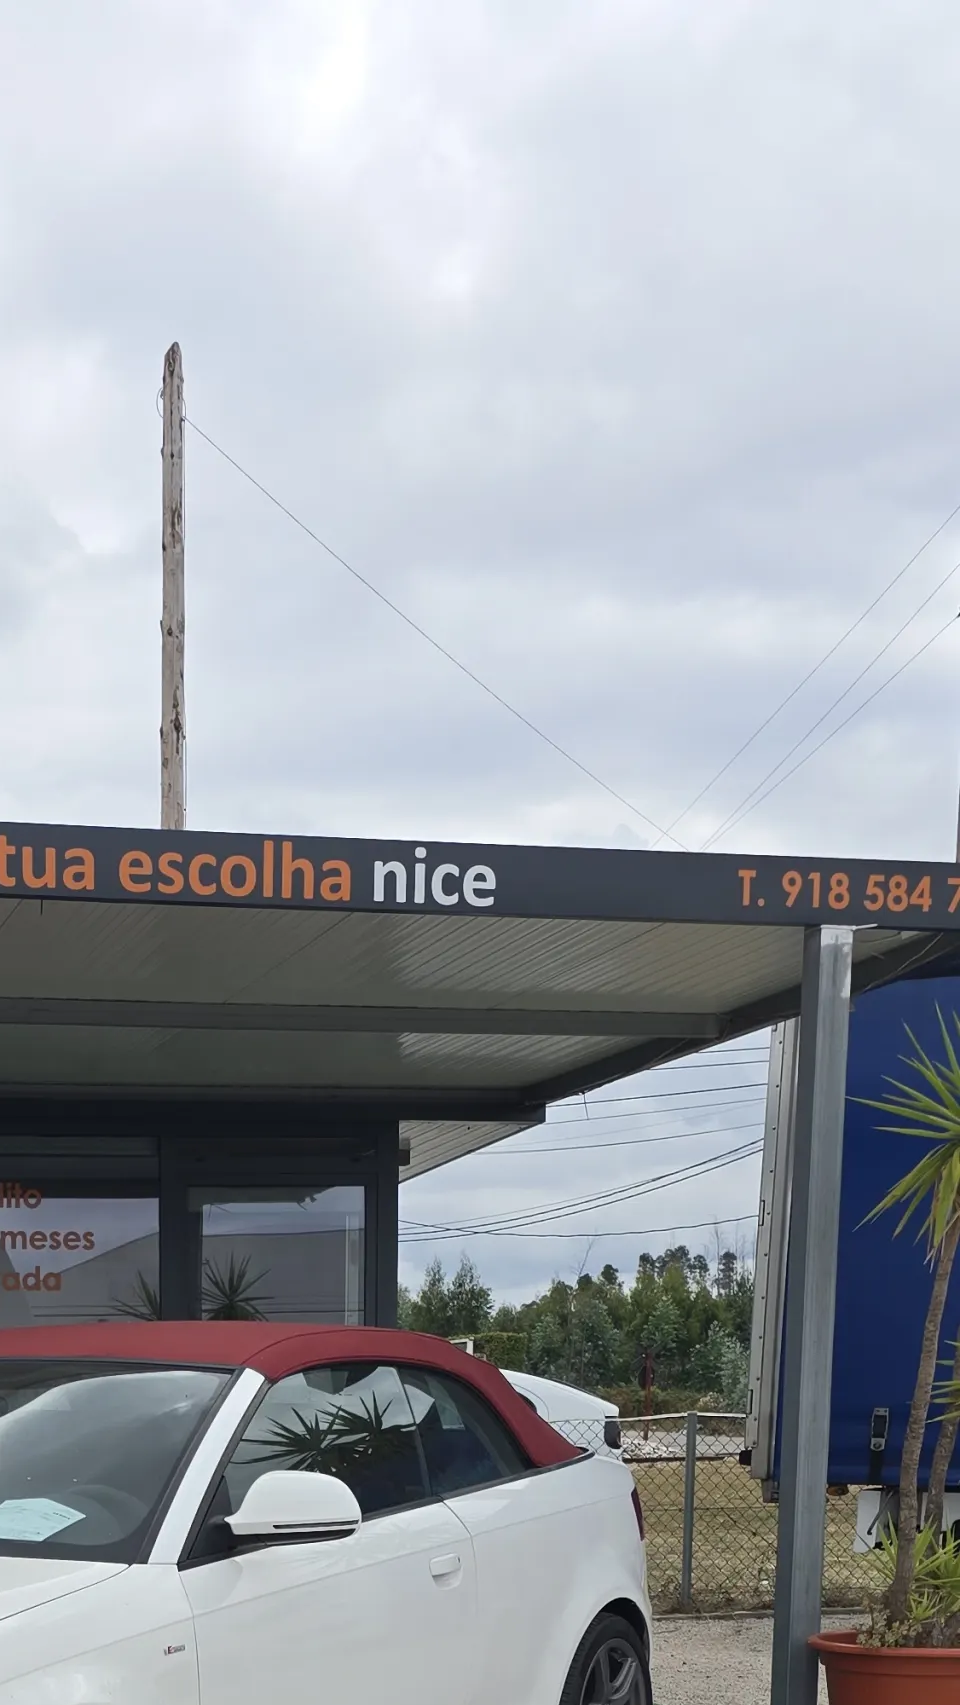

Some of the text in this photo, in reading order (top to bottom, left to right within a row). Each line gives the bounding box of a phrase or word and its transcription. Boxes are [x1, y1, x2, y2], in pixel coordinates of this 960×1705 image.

[118, 839, 352, 902] escolha
[372, 846, 497, 907] nice
[738, 869, 765, 907] T.
[781, 870, 850, 910] 918
[863, 874, 933, 912] 584
[0, 1229, 96, 1251] meses
